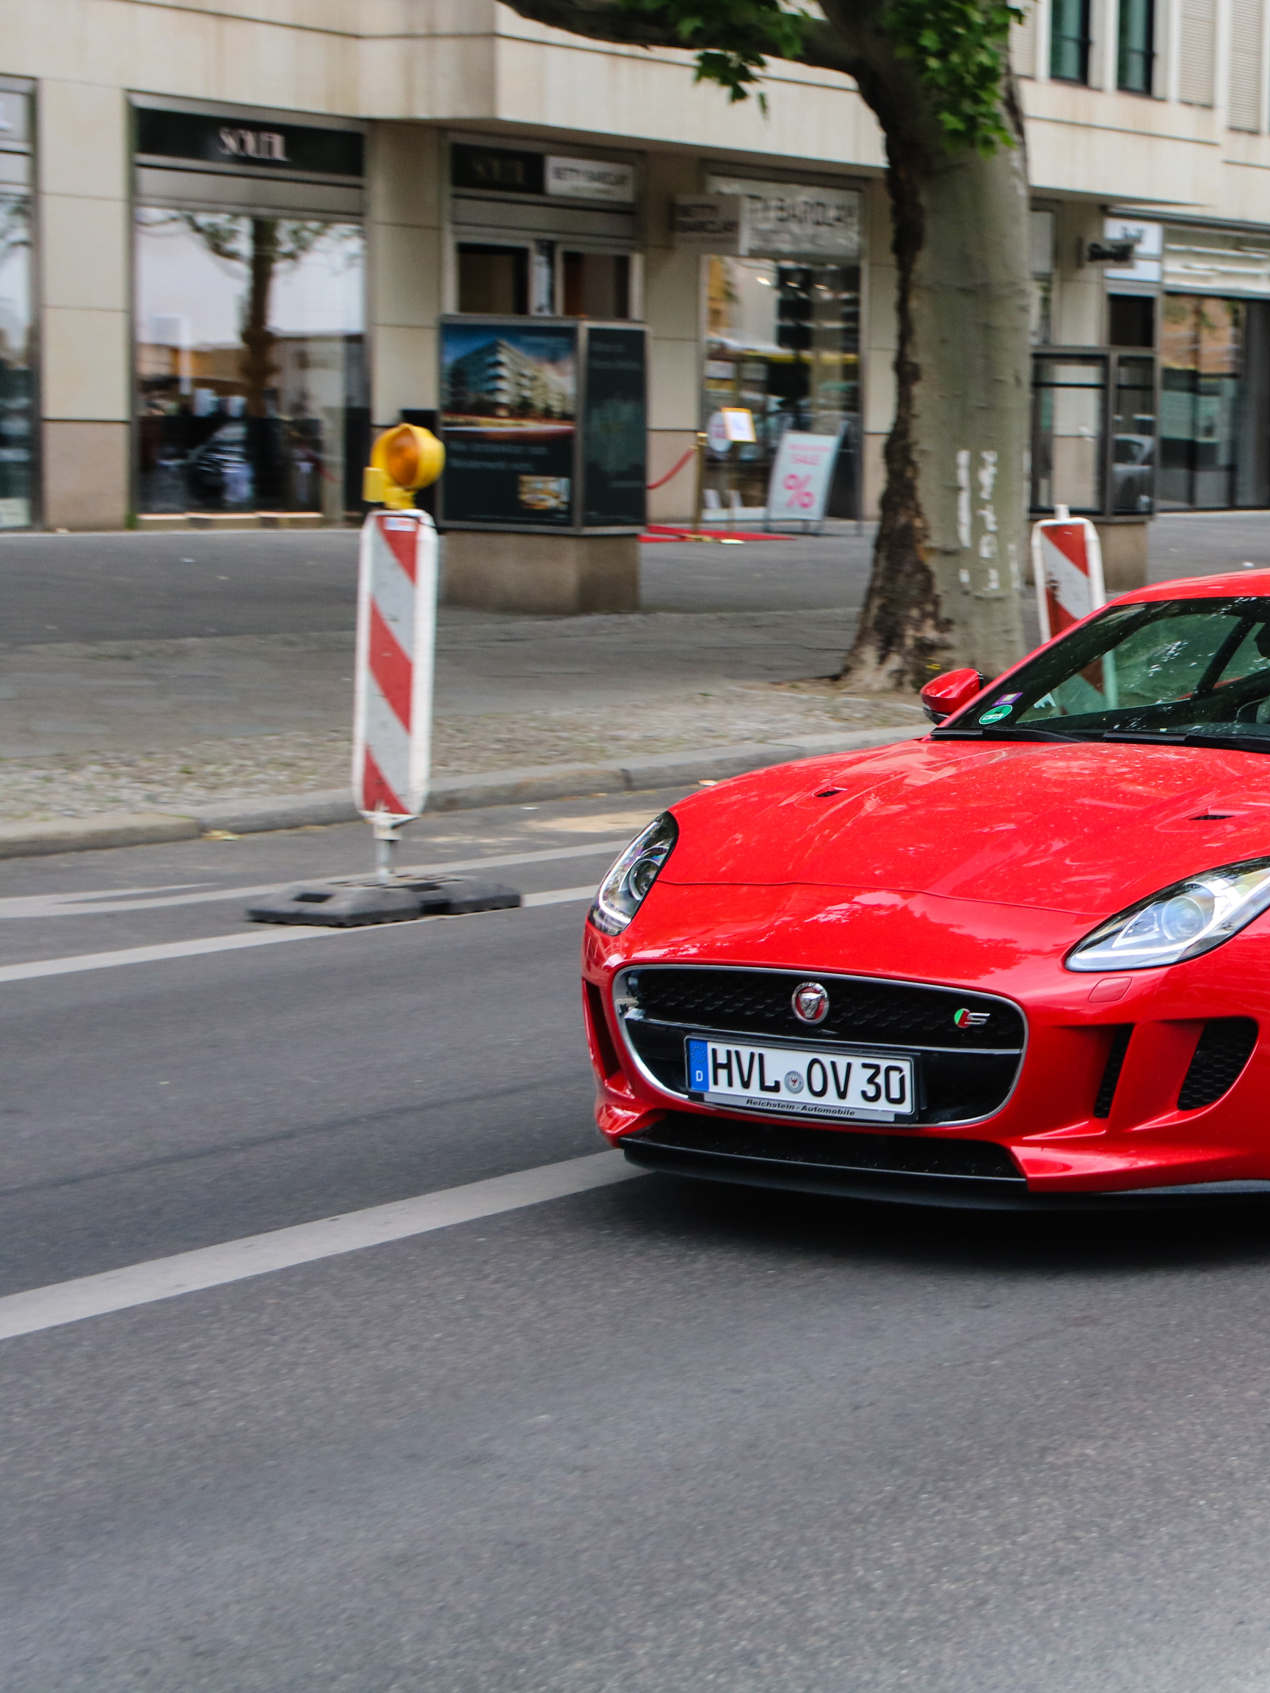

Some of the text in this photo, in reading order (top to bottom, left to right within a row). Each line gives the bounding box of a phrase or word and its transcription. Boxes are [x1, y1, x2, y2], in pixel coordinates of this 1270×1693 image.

[695, 1070, 703, 1082] D
[711, 1047, 906, 1105] HVL OV 30
[745, 1098, 795, 1111] Reichstein
[800, 1104, 856, 1117] Automobile
